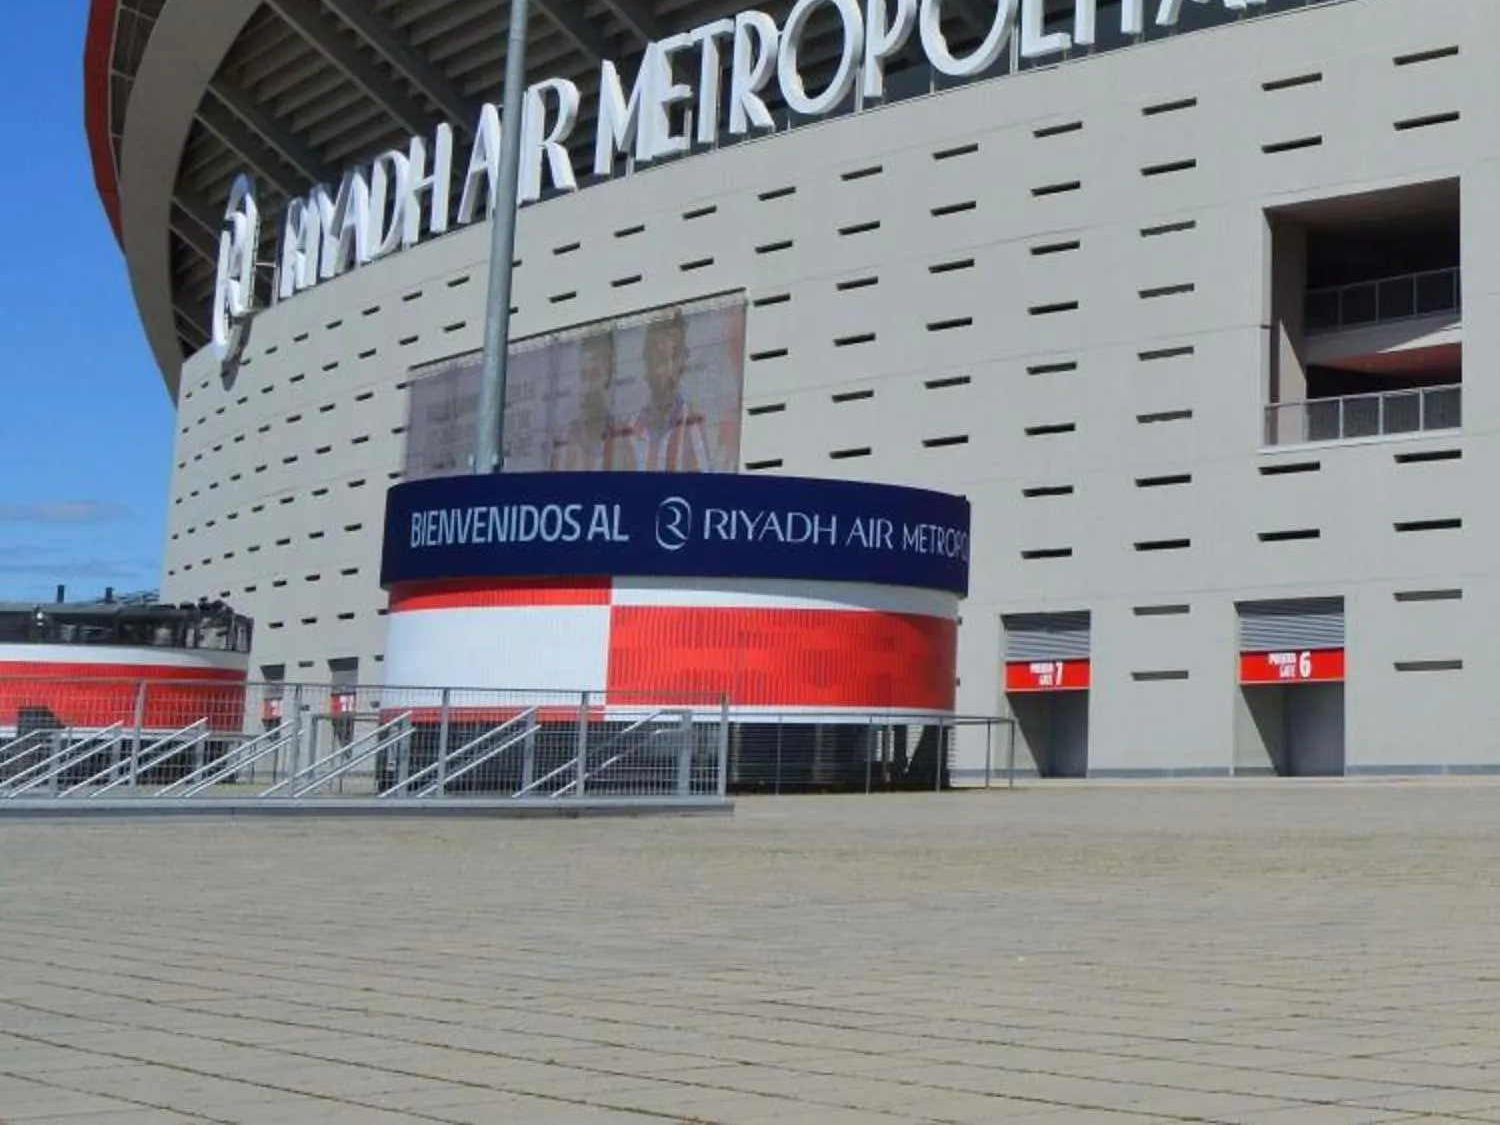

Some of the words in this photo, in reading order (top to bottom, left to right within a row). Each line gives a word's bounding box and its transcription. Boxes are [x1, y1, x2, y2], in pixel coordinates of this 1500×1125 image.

[276, 122, 453, 299] RIYADH
[457, 78, 581, 224] AR
[410, 503, 583, 548] BIENVENIDOS
[586, 503, 630, 542] AL
[703, 507, 837, 546] RIYADH
[846, 516, 893, 550] AIR
[1299, 650, 1312, 678] 6
